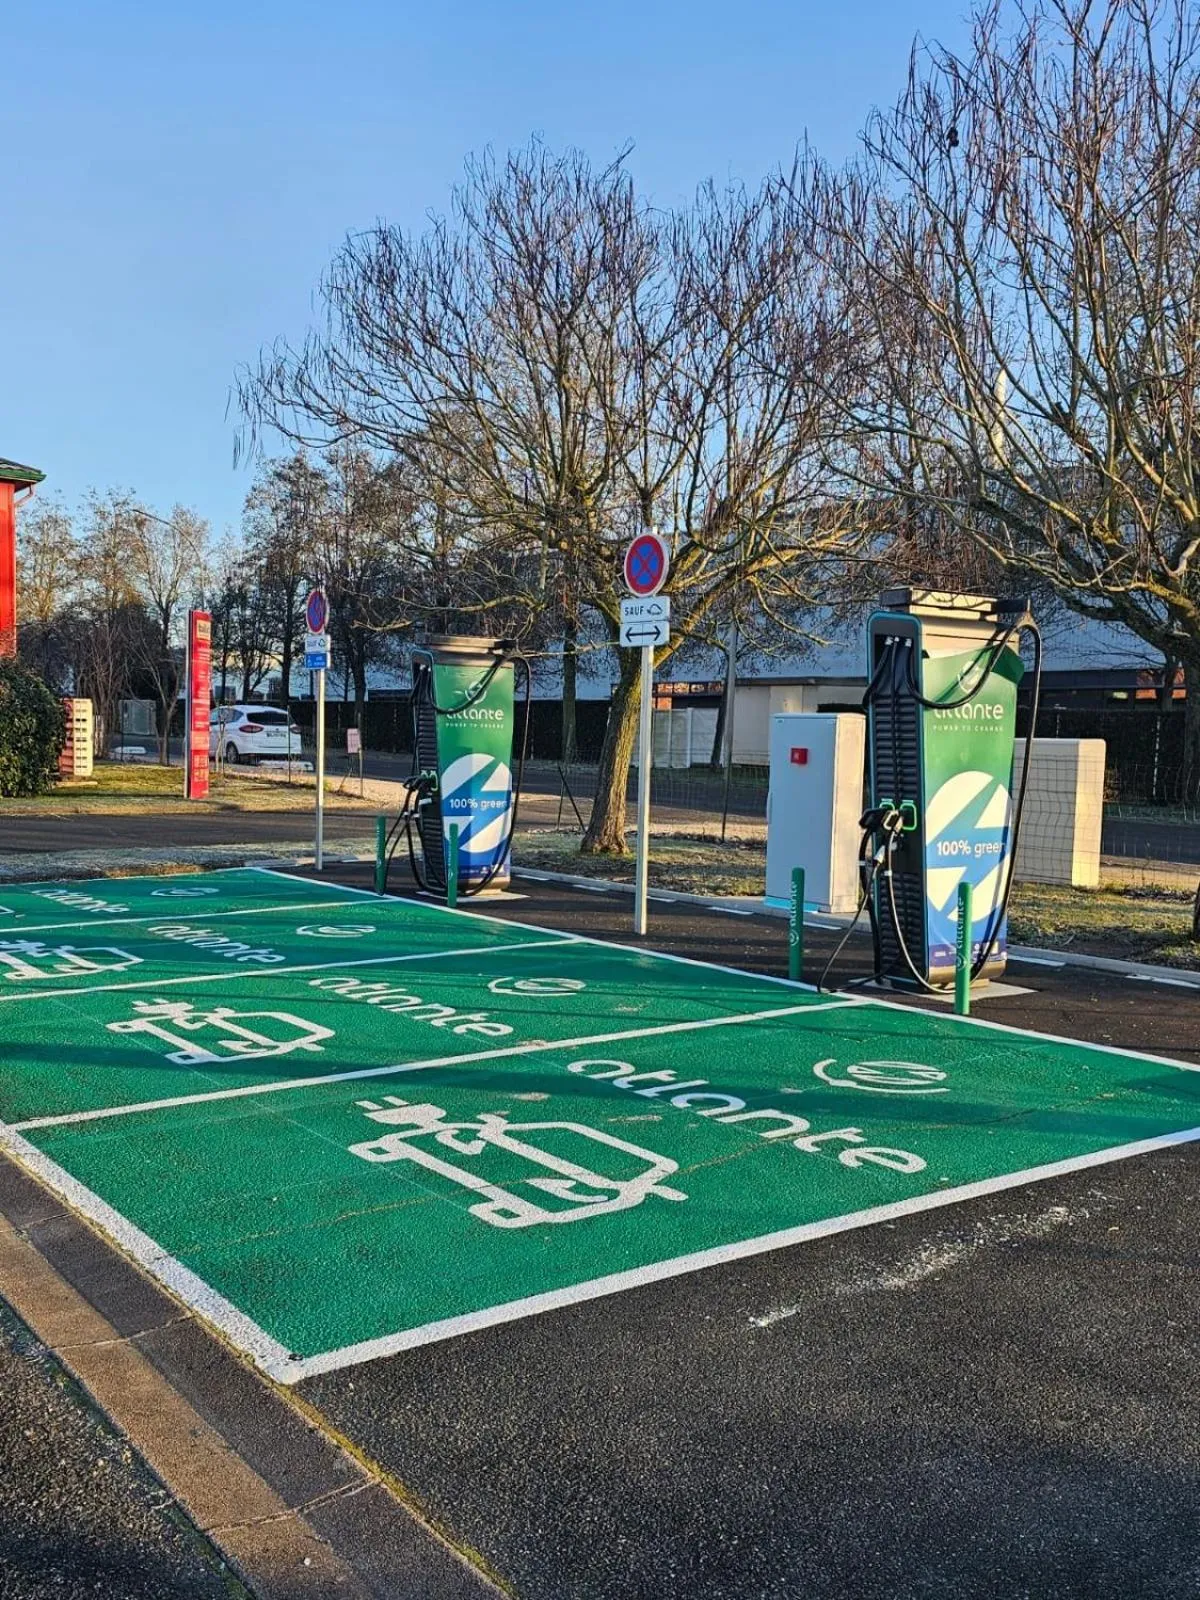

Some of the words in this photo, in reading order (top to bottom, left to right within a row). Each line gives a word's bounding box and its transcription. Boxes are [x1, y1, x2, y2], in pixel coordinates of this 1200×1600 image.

[624, 605, 644, 616] SAUF
[450, 798, 478, 809] 100%
[936, 839, 972, 856] 100%
[147, 925, 285, 964] atlante
[308, 976, 514, 1037] atlante
[567, 1058, 928, 1175] atlante
